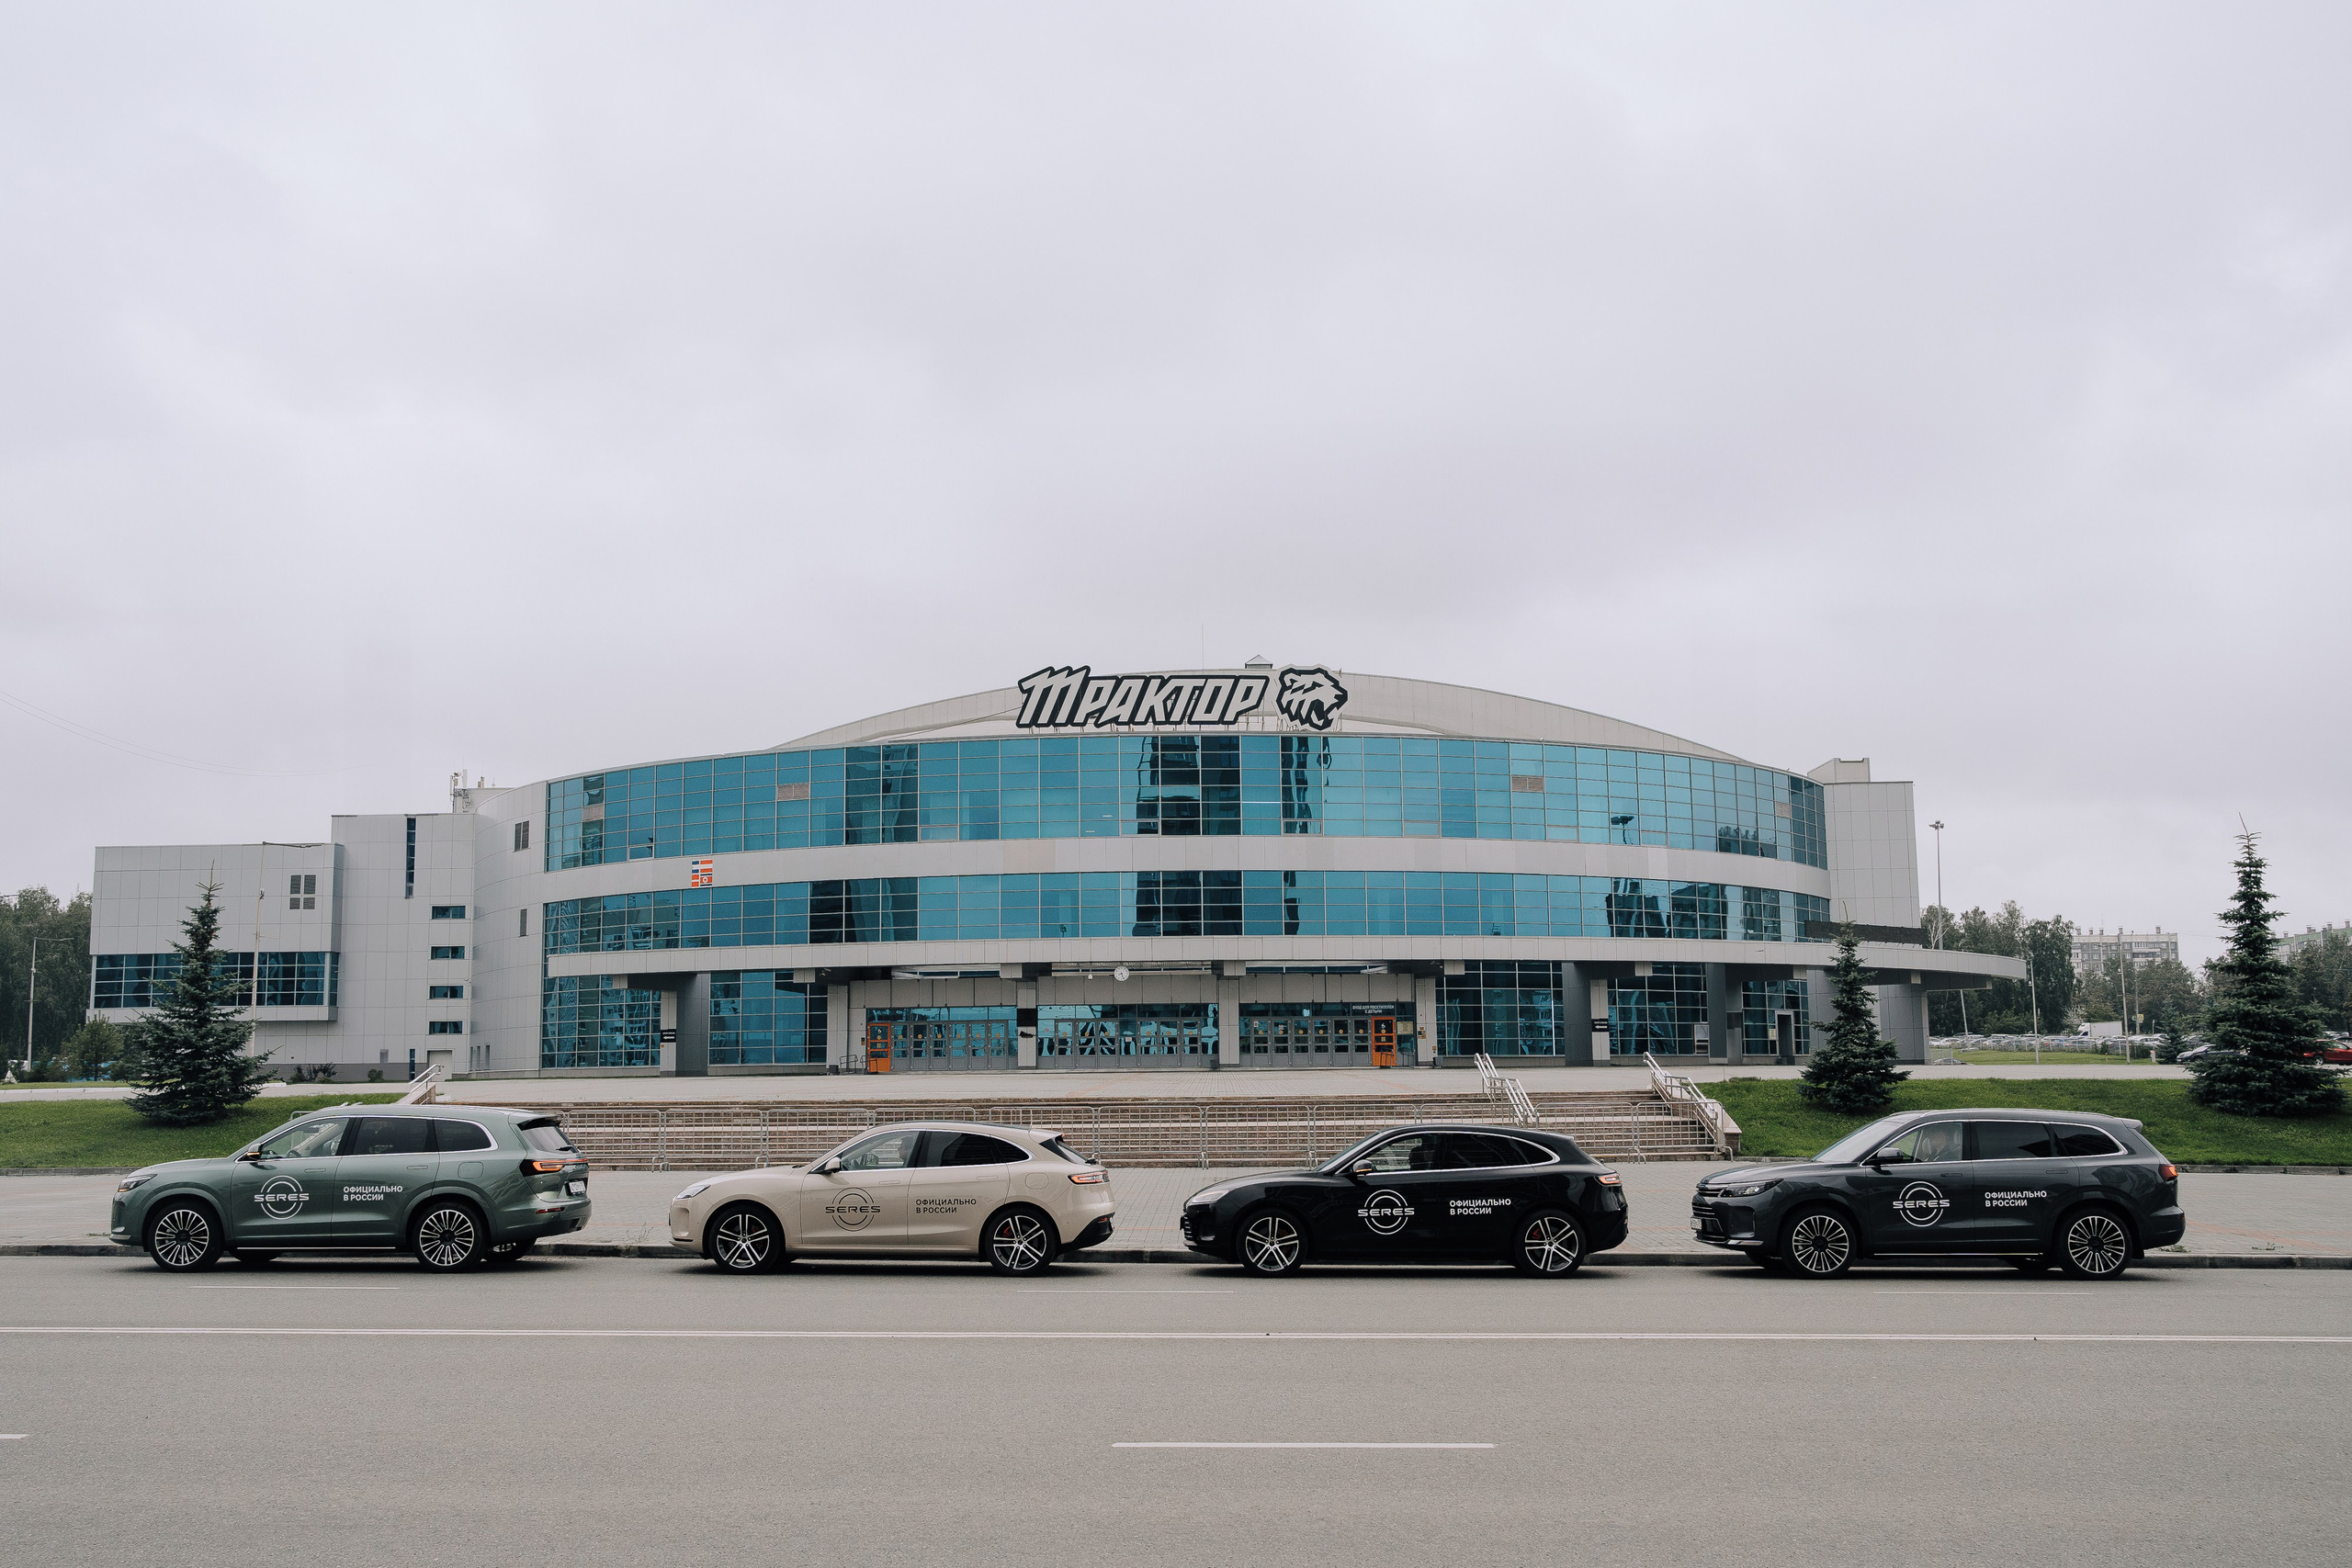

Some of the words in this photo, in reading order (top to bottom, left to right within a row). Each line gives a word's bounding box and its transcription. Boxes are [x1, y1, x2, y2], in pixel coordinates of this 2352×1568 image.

[1016, 665, 1270, 728] ТРАКТОР
[344, 1185, 403, 1193] ОФИЦИАЛЬНО
[254, 1193, 310, 1202] SERES
[350, 1193, 384, 1201] РОССИИ
[1984, 1190, 2047, 1199] ОФИЦИАЛЬНО
[915, 1198, 977, 1206] ОФИЦИАЛЬНО
[1449, 1198, 1511, 1207] ОФИЦИАЛЬНО
[1893, 1200, 1951, 1209] SERES
[1992, 1199, 2028, 1207] РОССИИ
[825, 1205, 881, 1213] SERES
[1358, 1207, 1415, 1217] SERES
[1457, 1207, 1492, 1215] РОССИИ
